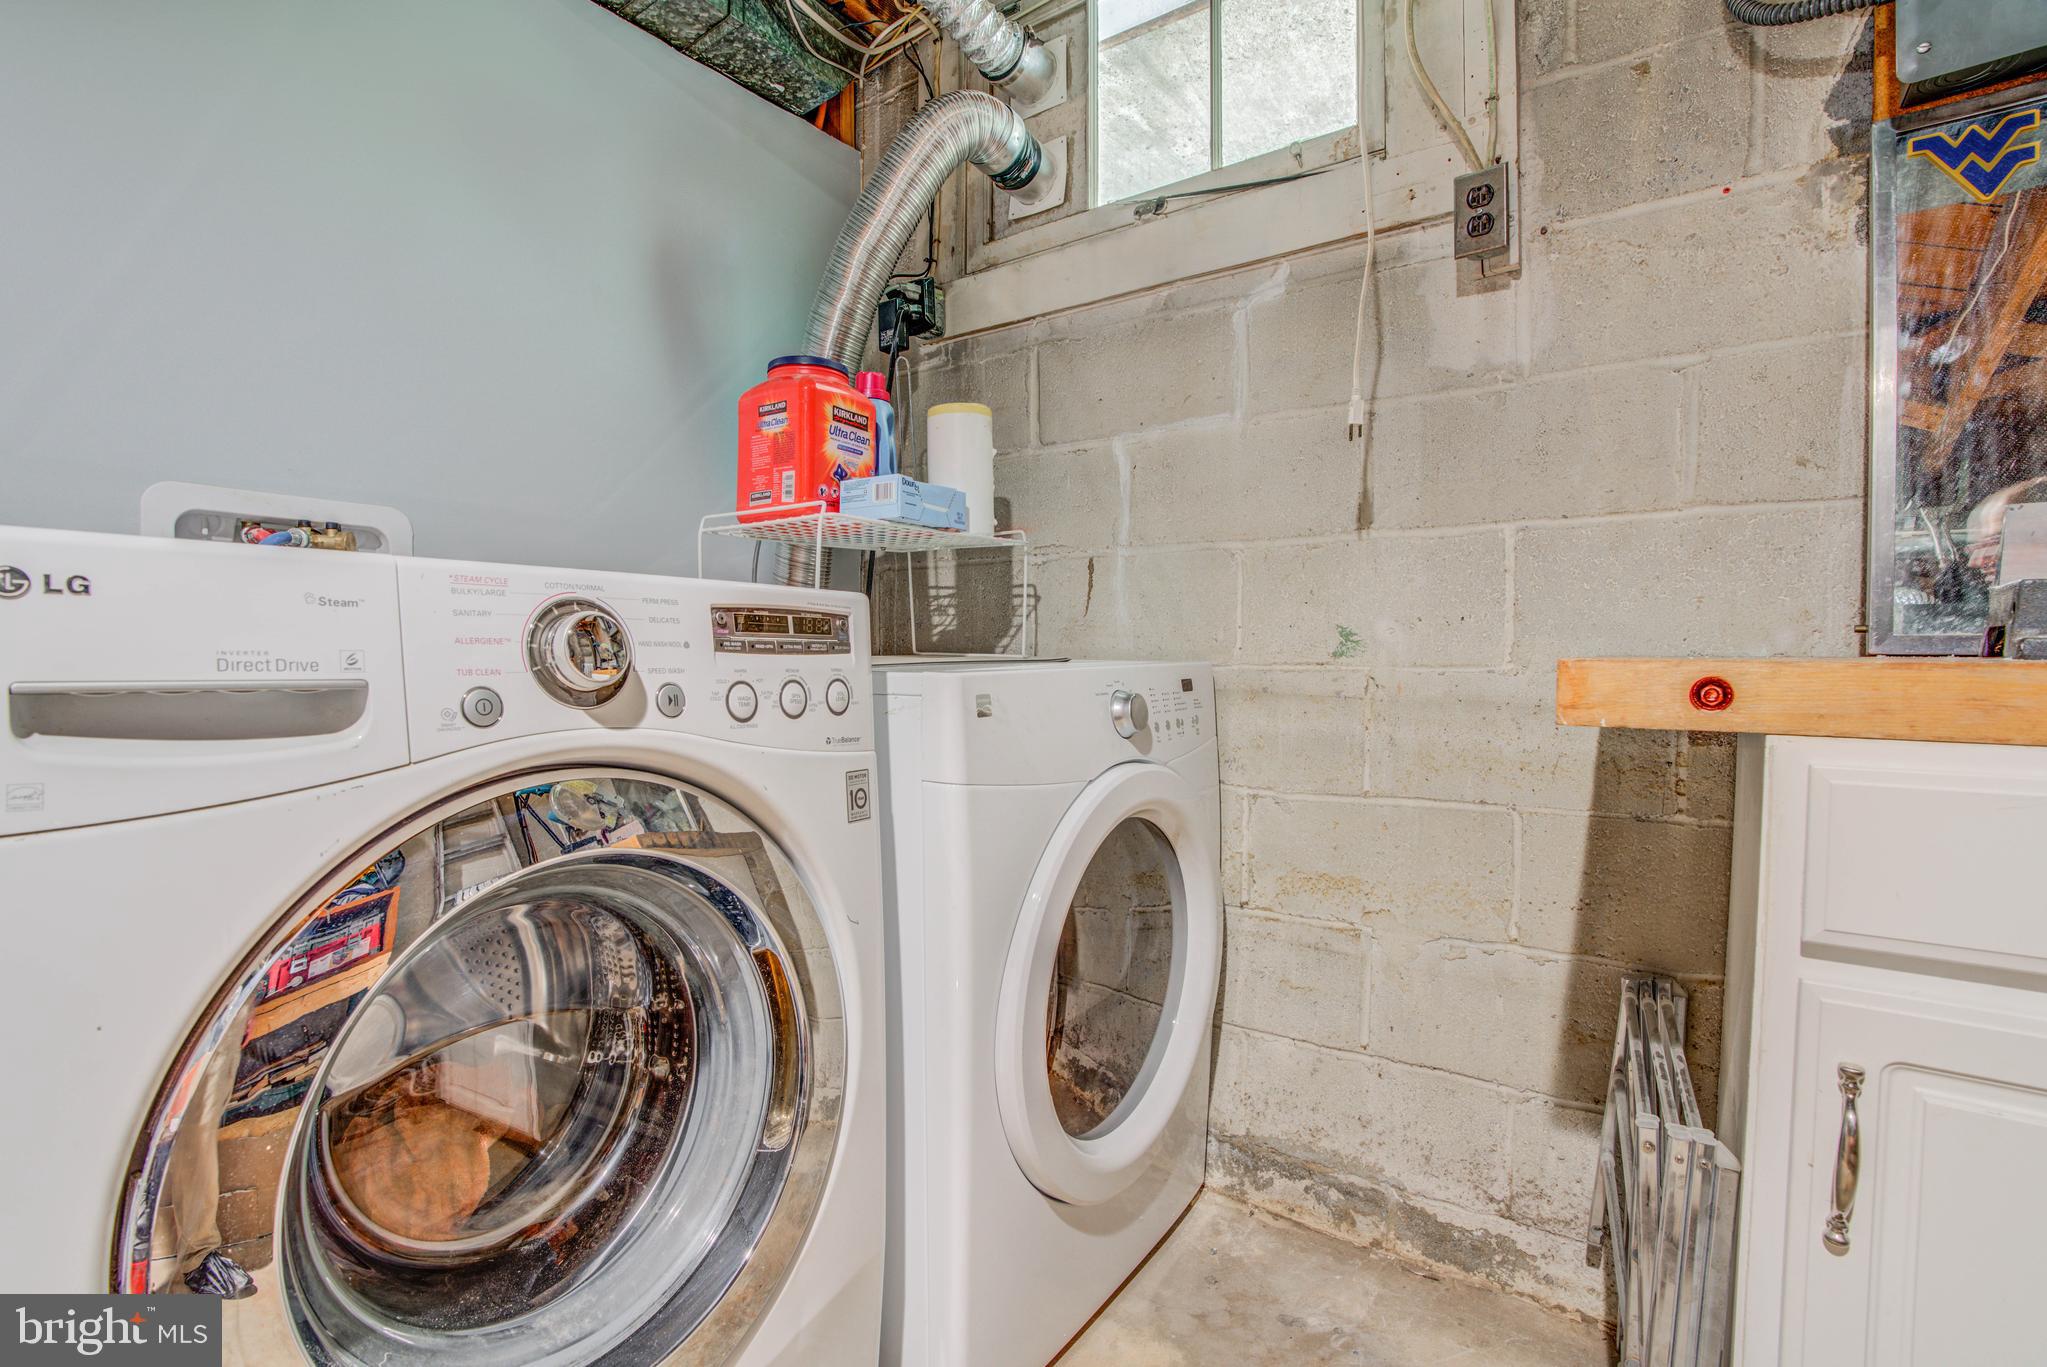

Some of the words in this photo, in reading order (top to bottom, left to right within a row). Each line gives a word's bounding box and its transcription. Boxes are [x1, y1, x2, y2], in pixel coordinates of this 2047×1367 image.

[759, 401, 787, 412] KIRKLAND
[833, 407, 868, 425] KIRKLAND
[849, 431, 871, 447] Clean
[43, 574, 91, 596] LG
[452, 608, 493, 618] SANITARY
[648, 617, 681, 625] DELICATES
[216, 658, 272, 672] Direct
[275, 658, 320, 672] Drive
[456, 668, 473, 677] TUB
[475, 669, 502, 677] CLEAN
[849, 787, 867, 811] 10
